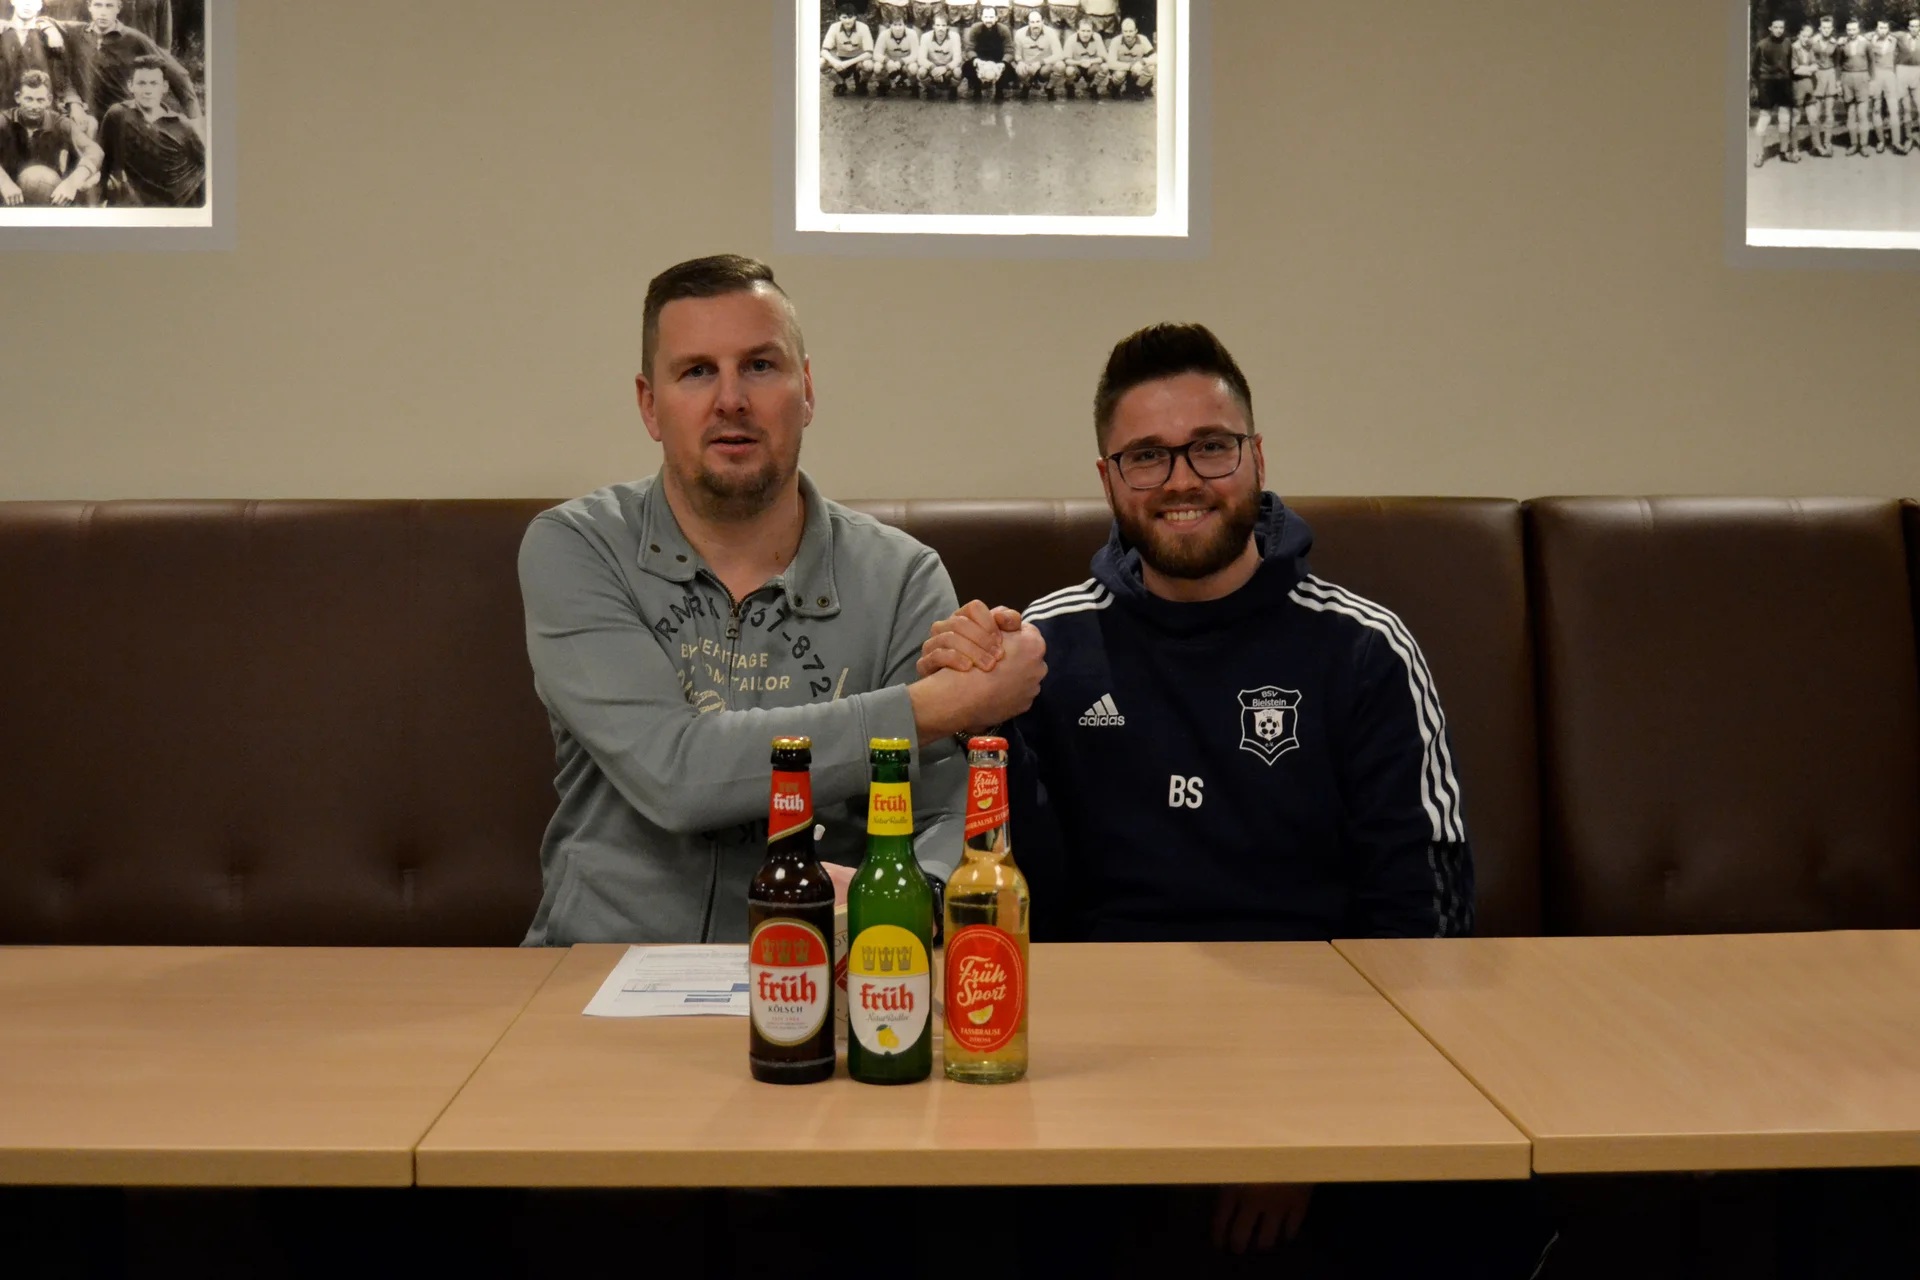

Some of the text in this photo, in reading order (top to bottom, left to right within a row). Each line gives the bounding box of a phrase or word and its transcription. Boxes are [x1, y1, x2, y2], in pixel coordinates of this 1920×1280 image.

[681, 643, 698, 659] BY
[1252, 698, 1287, 707] Bielstein
[1261, 690, 1278, 698] BSV
[1078, 714, 1125, 727] adidas
[974, 770, 999, 787] Früh
[973, 783, 999, 798] Sport
[1168, 774, 1204, 809] BS
[773, 792, 805, 812] früh
[873, 792, 907, 813] früh
[958, 955, 1008, 986] Früh
[758, 971, 817, 1005] früh
[956, 979, 1007, 1007] Sport
[859, 983, 914, 1013] früh
[768, 1004, 803, 1013] KÖLSCH
[960, 1027, 1001, 1036] FASSBRAUSE
